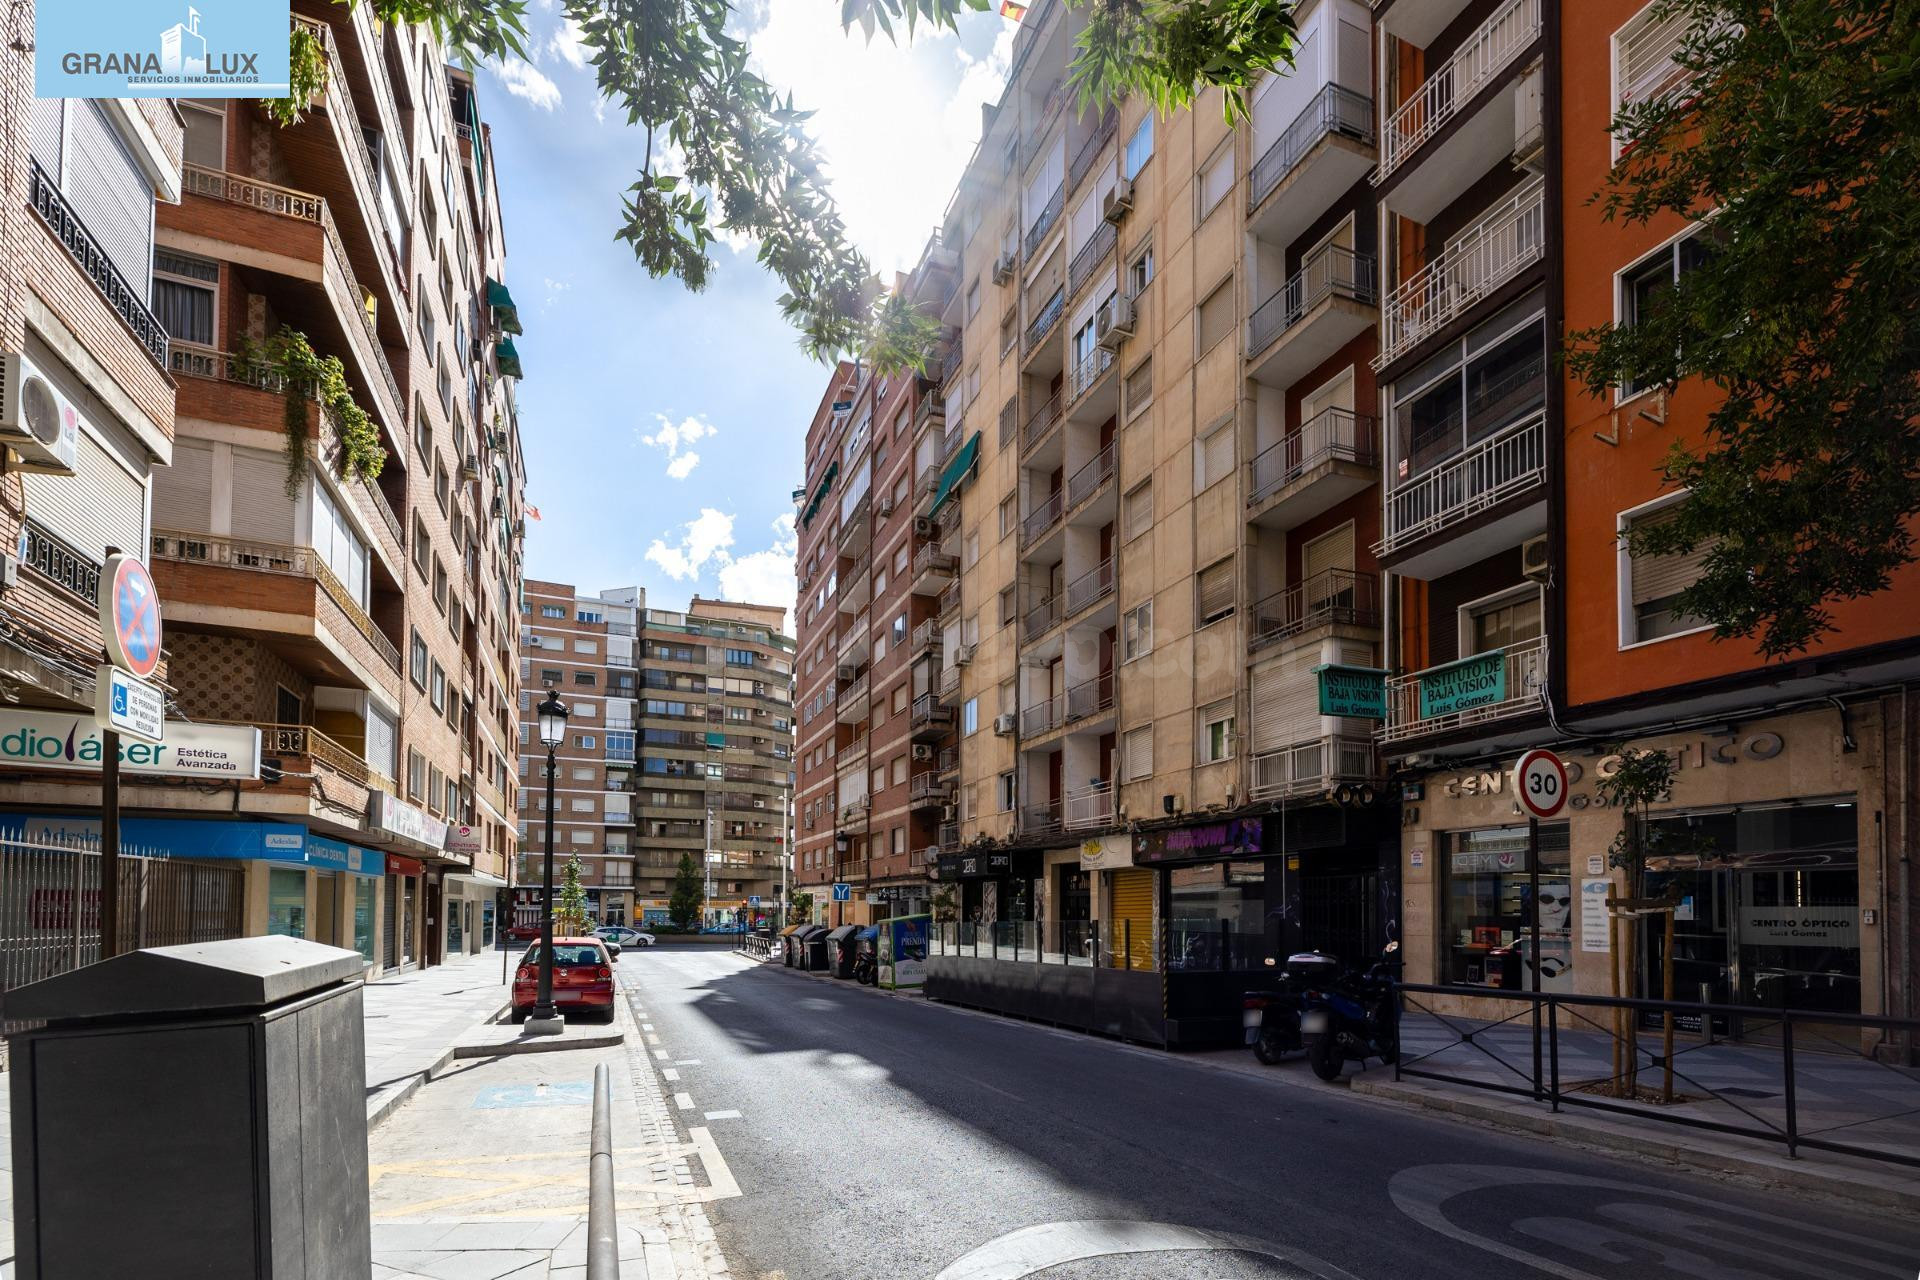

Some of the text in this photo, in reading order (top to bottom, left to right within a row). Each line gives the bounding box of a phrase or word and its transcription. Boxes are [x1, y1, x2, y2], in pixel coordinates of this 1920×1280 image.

[1325, 671, 1384, 691] INSTITUTO DE
[1423, 659, 1502, 691] INSTITUTO DE
[1328, 686, 1381, 703] BAJA VISION
[1427, 674, 1498, 703] BAJA VISION
[132, 696, 157, 713] DE PERSONAS
[1330, 702, 1380, 716] Luis Gómez
[1430, 692, 1495, 716] Luis Gómez
[130, 706, 159, 725] CON MOVILIDAD
[135, 720, 154, 733] REDUCIDA
[177, 747, 228, 760] Estética
[176, 758, 237, 771] Avanzada
[1529, 772, 1558, 796] 30
[270, 837, 298, 846] Adeslas
[329, 848, 346, 863] DENTAL
[1751, 917, 1850, 929] CENTRO ÓPTICO
[901, 936, 926, 947] PRENDA
